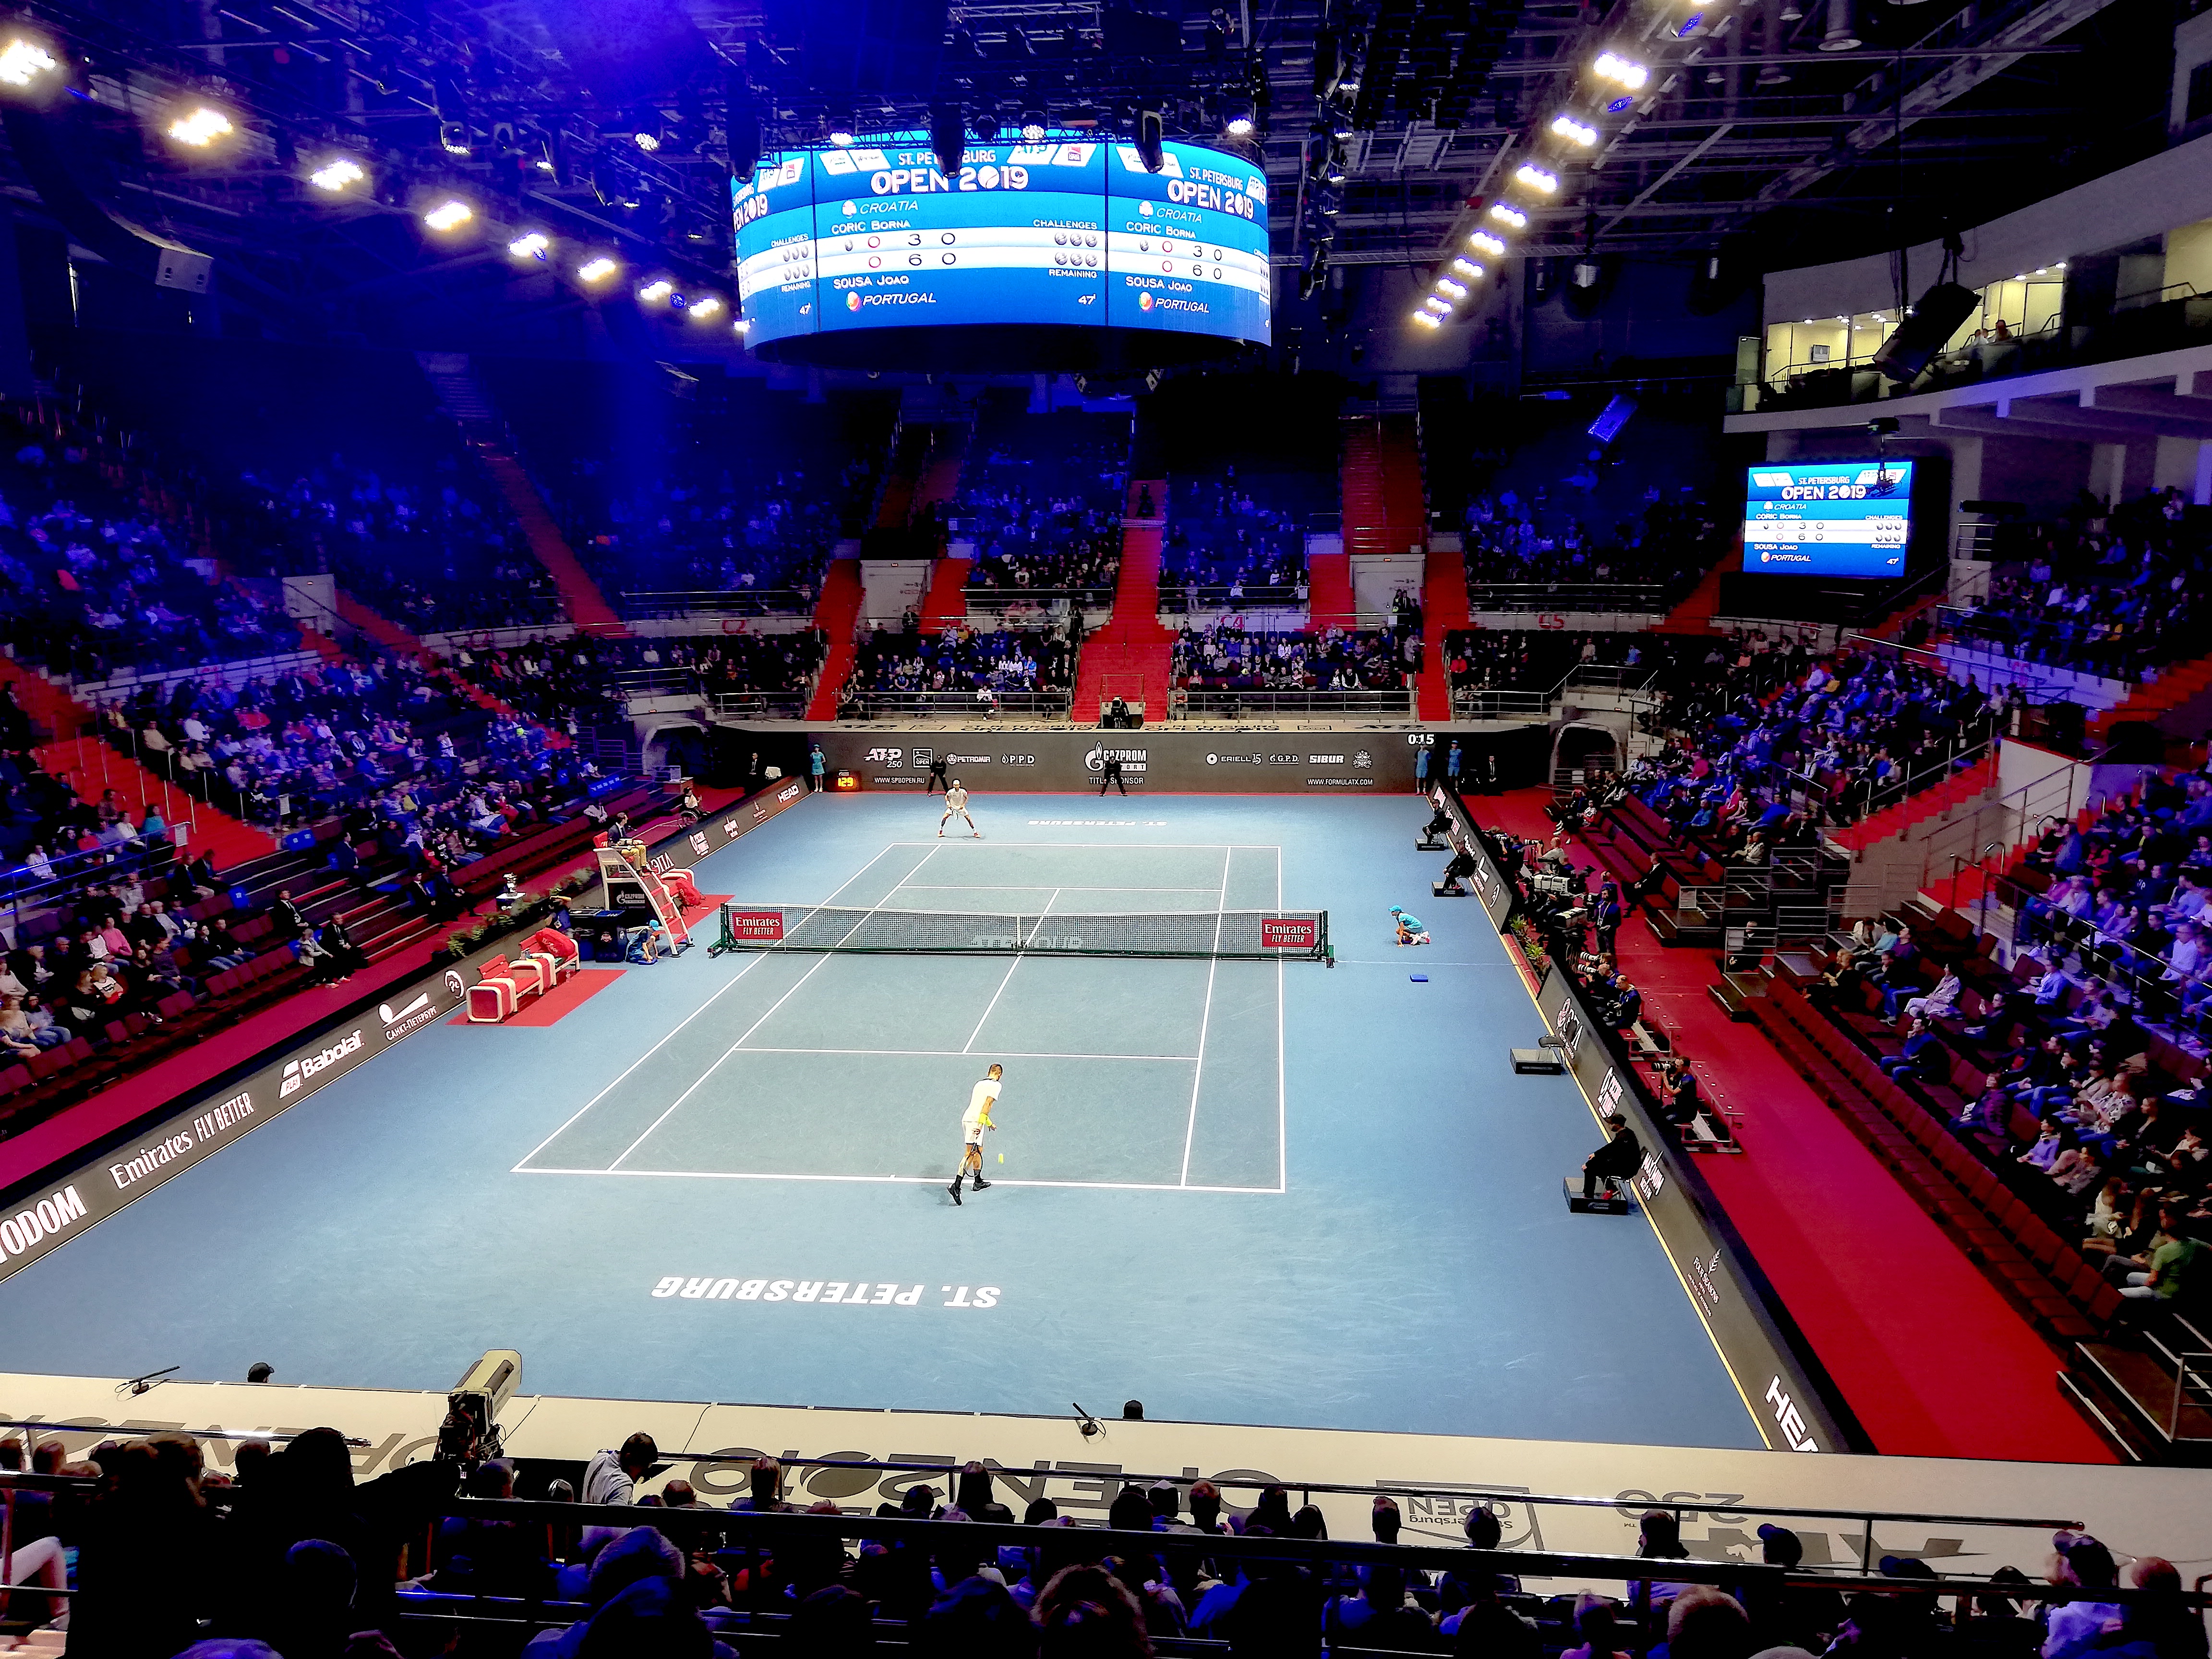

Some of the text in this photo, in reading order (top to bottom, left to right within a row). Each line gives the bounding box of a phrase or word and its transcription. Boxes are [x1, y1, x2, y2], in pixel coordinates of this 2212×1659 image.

[916, 149, 997, 165] PETBURG
[871, 165, 1029, 194] OPEN 2019
[1200, 168, 1243, 191] PETERSBURG
[1167, 180, 1254, 219] OPEN 2019
[859, 200, 919, 215] CROATIA
[1156, 207, 1202, 224] CROATIA
[831, 223, 866, 235] CORIC
[1033, 219, 1098, 230] CHALLENGES
[1126, 221, 1162, 235] CORIC
[770, 233, 809, 248] CHALLENGES
[908, 233, 921, 246] 3
[1193, 245, 1202, 258] 3
[908, 253, 922, 266] 6
[1048, 269, 1098, 279] REMAINING
[1192, 265, 1202, 276] 6
[781, 280, 811, 292] REMAINING
[833, 276, 871, 289] SOUSA
[1126, 276, 1165, 289] SOUSA
[862, 293, 937, 306] PORTUGAL
[1155, 297, 1210, 313] PORTUGAL
[1809, 475, 1850, 485] PETERSBURG
[1781, 485, 1866, 500] OPEN 2019
[1798, 533, 1805, 541] 6
[1407, 733, 1435, 745] 0:15
[864, 748, 903, 761] ATP
[957, 755, 991, 763] PETROMIR
[1103, 749, 1147, 761] GAZPROM
[1309, 755, 1345, 764] SIBUR
[886, 760, 903, 768] 250
[838, 777, 854, 787] 129
[777, 783, 799, 803] HEAD
[735, 916, 781, 927] Emirates
[743, 926, 774, 936] FLY BETTER
[1264, 924, 1312, 934] Emirates
[1271, 934, 1305, 943] FLY BETTER
[286, 1078, 299, 1092] PLAY
[108, 1092, 255, 1190] Emirates FLY BETTER
[0, 1185, 88, 1264] ODOM
[650, 1276, 1002, 1309] ST. PETERSBURG
